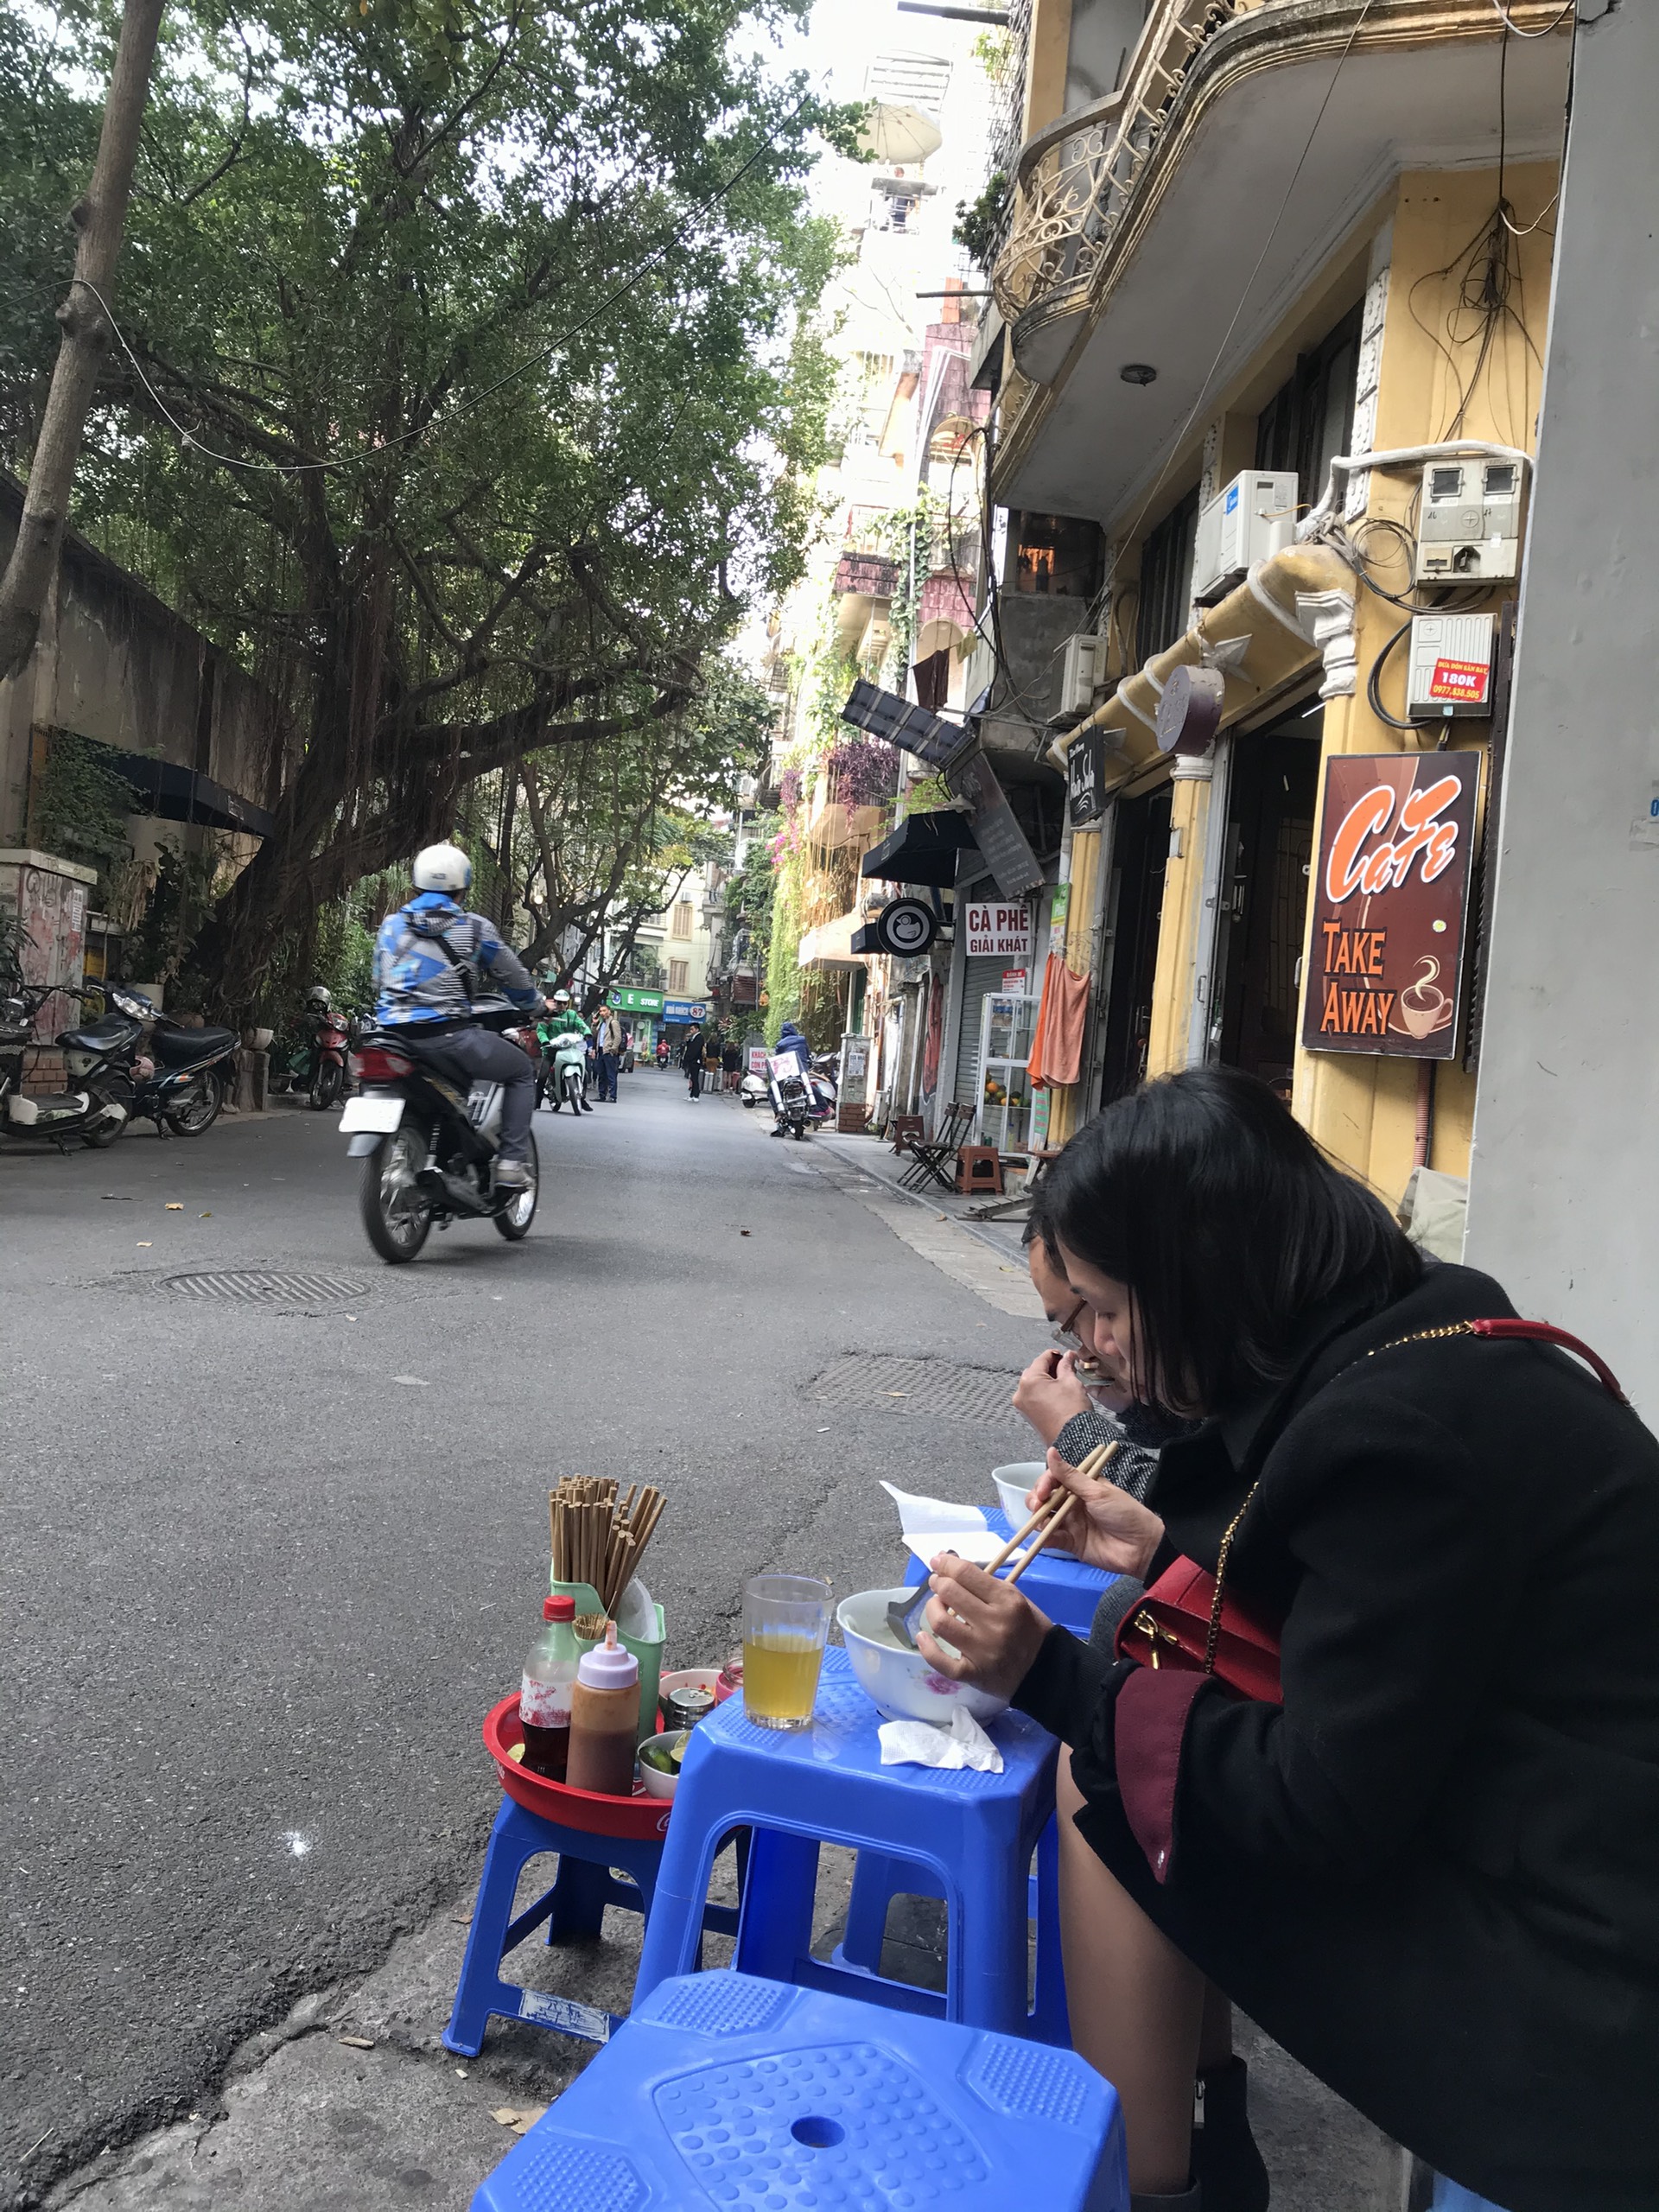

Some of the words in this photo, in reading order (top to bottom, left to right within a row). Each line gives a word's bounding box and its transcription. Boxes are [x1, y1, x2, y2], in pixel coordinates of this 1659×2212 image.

[1442, 671, 1477, 688] 180K
[969, 905, 991, 932] CÀ
[996, 904, 1029, 931] PHÊ
[969, 934, 994, 953] GIẢI
[997, 936, 1028, 952] KHÁT
[640, 998, 659, 1007] STORE
[692, 1007, 703, 1016] 87
